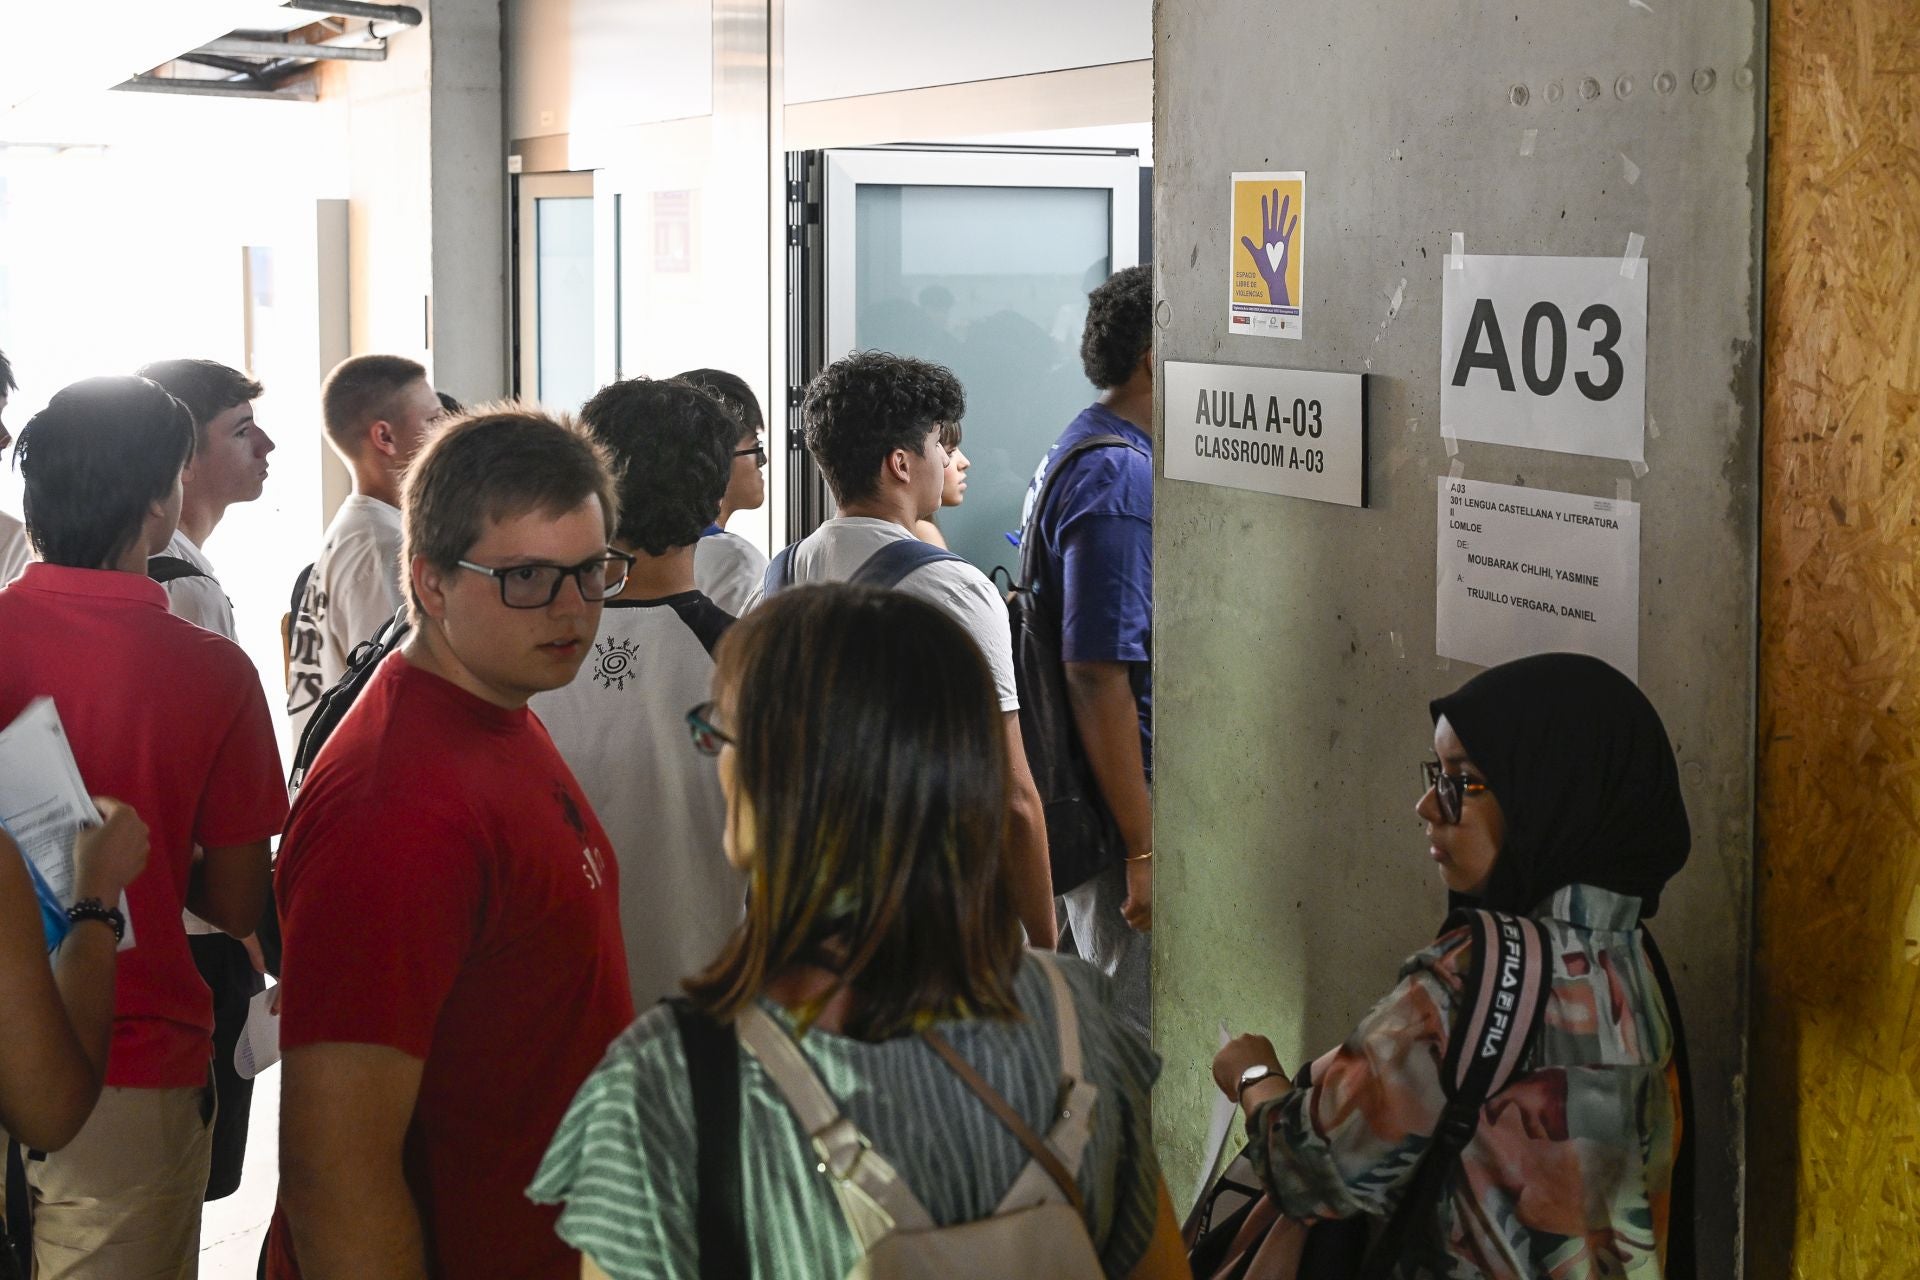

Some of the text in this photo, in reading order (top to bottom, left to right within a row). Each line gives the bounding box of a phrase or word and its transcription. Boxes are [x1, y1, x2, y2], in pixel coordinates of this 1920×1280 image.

[1236, 290, 1264, 298] VIOLENCIAS
[1451, 298, 1624, 402] A03
[1195, 388, 1323, 439] AULA A-03
[1195, 434, 1324, 474] CLASSROOM A-03
[1450, 483, 1466, 494] A03
[1450, 496, 1619, 530] 301 LENGUA CASTELLANA Y LITERATURA
[1450, 520, 1482, 533] LOMLOE
[1456, 539, 1469, 549] DE:
[1457, 574, 1464, 583] A:
[1467, 553, 1599, 587] MOUBARAK CHLIHI, YASMINE
[1467, 587, 1597, 623] TRUJILLO VERGARA, DANIEL
[1501, 940, 1521, 989] FILA
[1481, 1012, 1510, 1058] FILA
